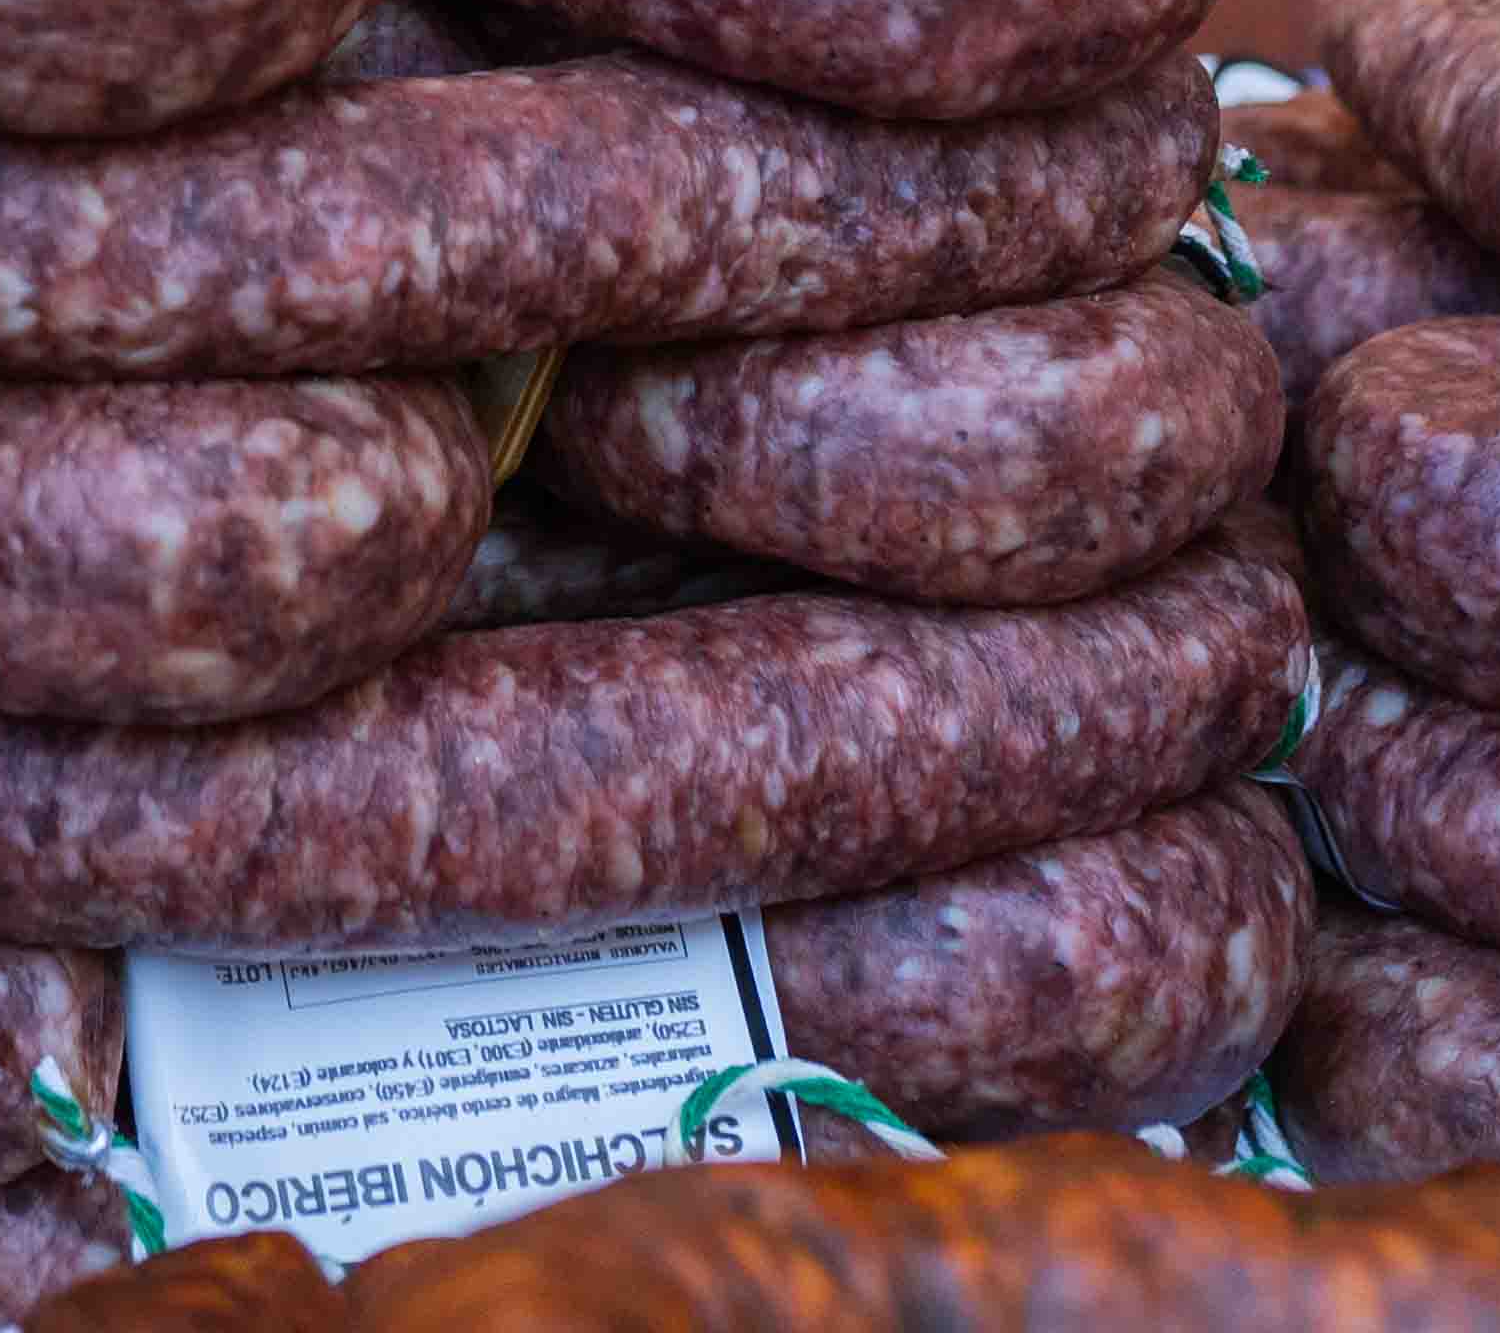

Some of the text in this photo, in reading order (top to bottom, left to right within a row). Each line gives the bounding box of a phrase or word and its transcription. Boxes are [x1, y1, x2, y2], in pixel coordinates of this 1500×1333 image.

[589, 998, 665, 1023] GLUTEN
[667, 994, 700, 1012] SIN
[446, 1013, 535, 1041] LACTOSA
[542, 1008, 575, 1028] SIN
[316, 1057, 398, 1081] colorante
[402, 1050, 414, 1068] y
[235, 1086, 366, 1117] conservadores
[462, 1096, 512, 1117] cerdo
[517, 1093, 539, 1111] de
[542, 1086, 601, 1109] Magro
[363, 1112, 389, 1131] sal
[208, 1121, 289, 1148] especias
[205, 1161, 410, 1225] IBÉRICO
